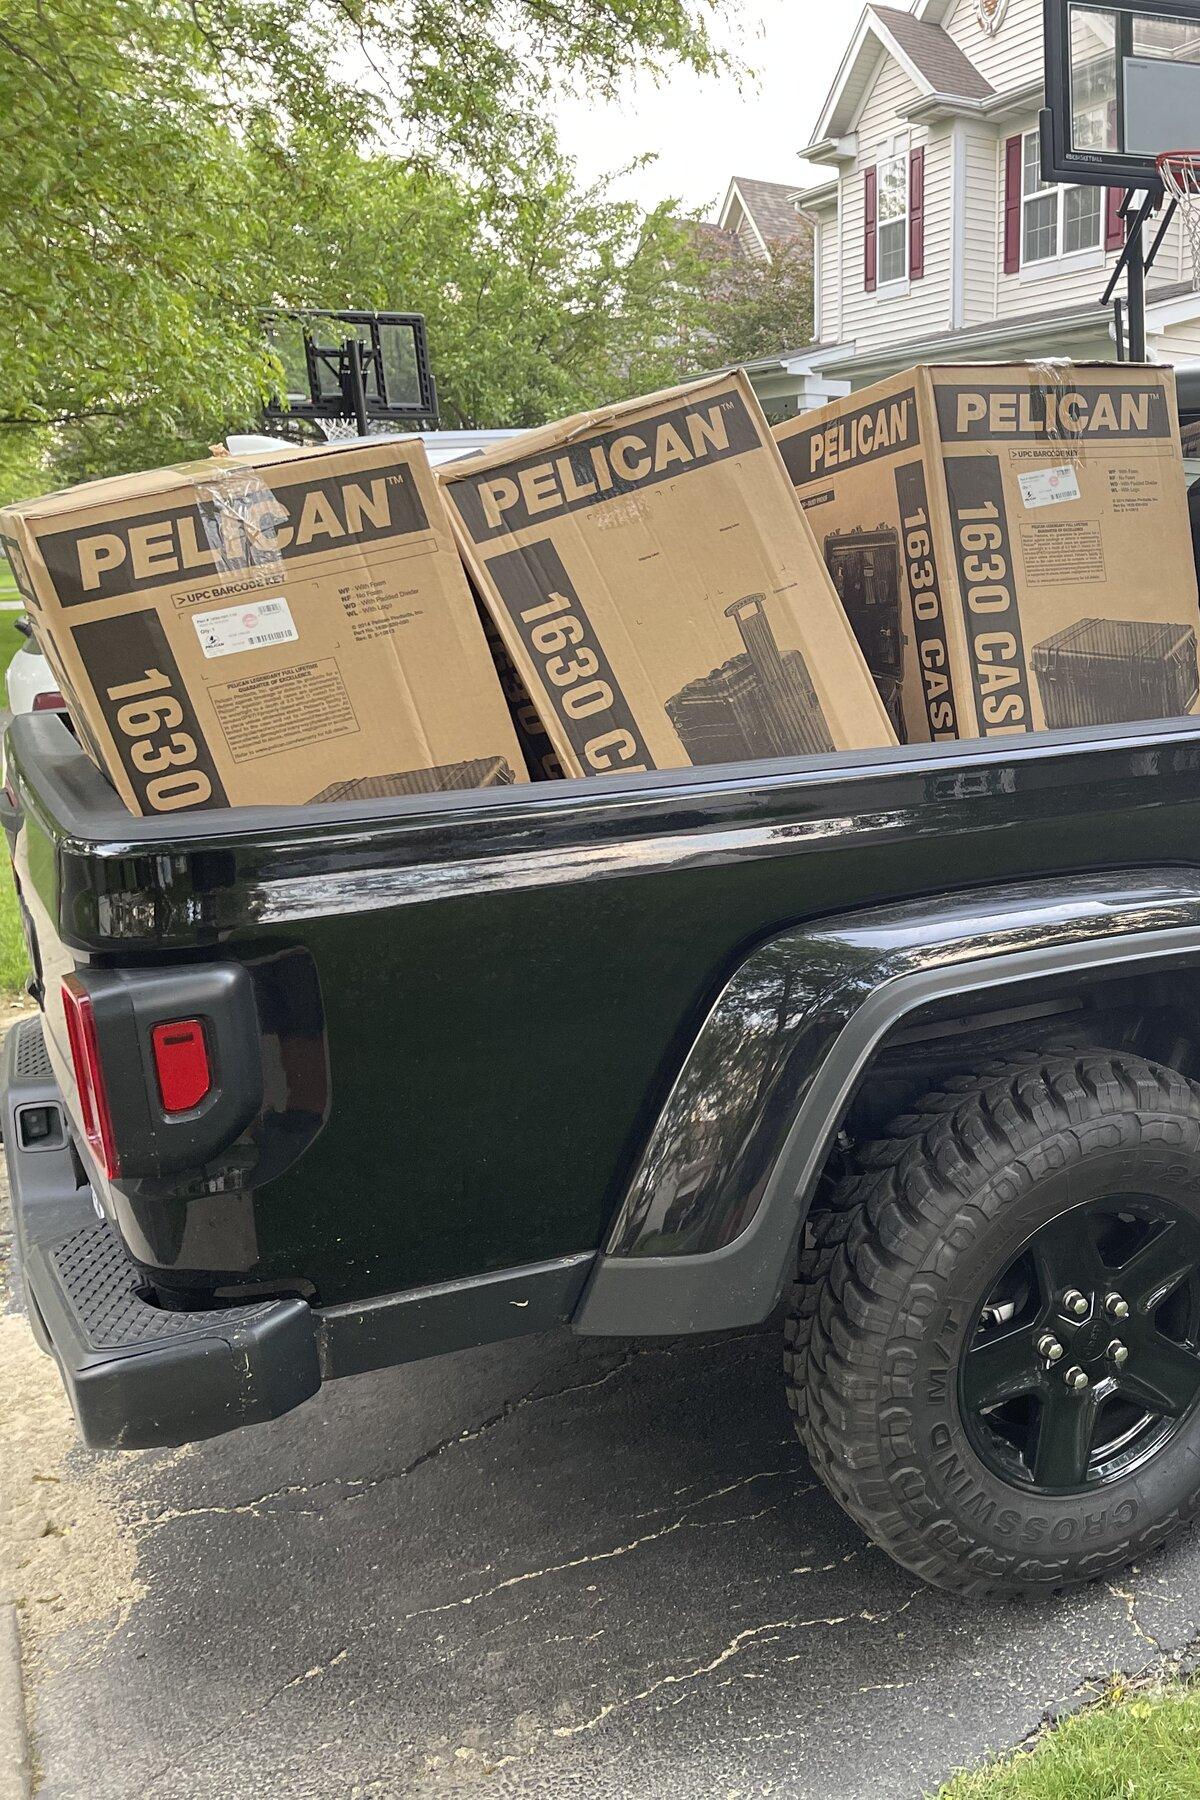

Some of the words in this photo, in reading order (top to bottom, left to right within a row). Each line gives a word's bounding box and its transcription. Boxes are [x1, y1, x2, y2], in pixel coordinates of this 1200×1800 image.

[477, 406, 729, 529] PELICAN
[810, 400, 908, 473] PELICAN
[957, 393, 1149, 433] PELICAN
[76, 476, 392, 591] PELICAN
[187, 590, 211, 603] UPC
[212, 579, 264, 598] BARCODE
[264, 574, 287, 586] KEY
[904, 507, 939, 621] 1630
[957, 501, 1011, 614] 1630
[106, 668, 212, 812] 1630
[520, 591, 614, 720] 1630
[584, 728, 648, 777] C
[930, 1422, 1139, 1545] CROSSWIND
